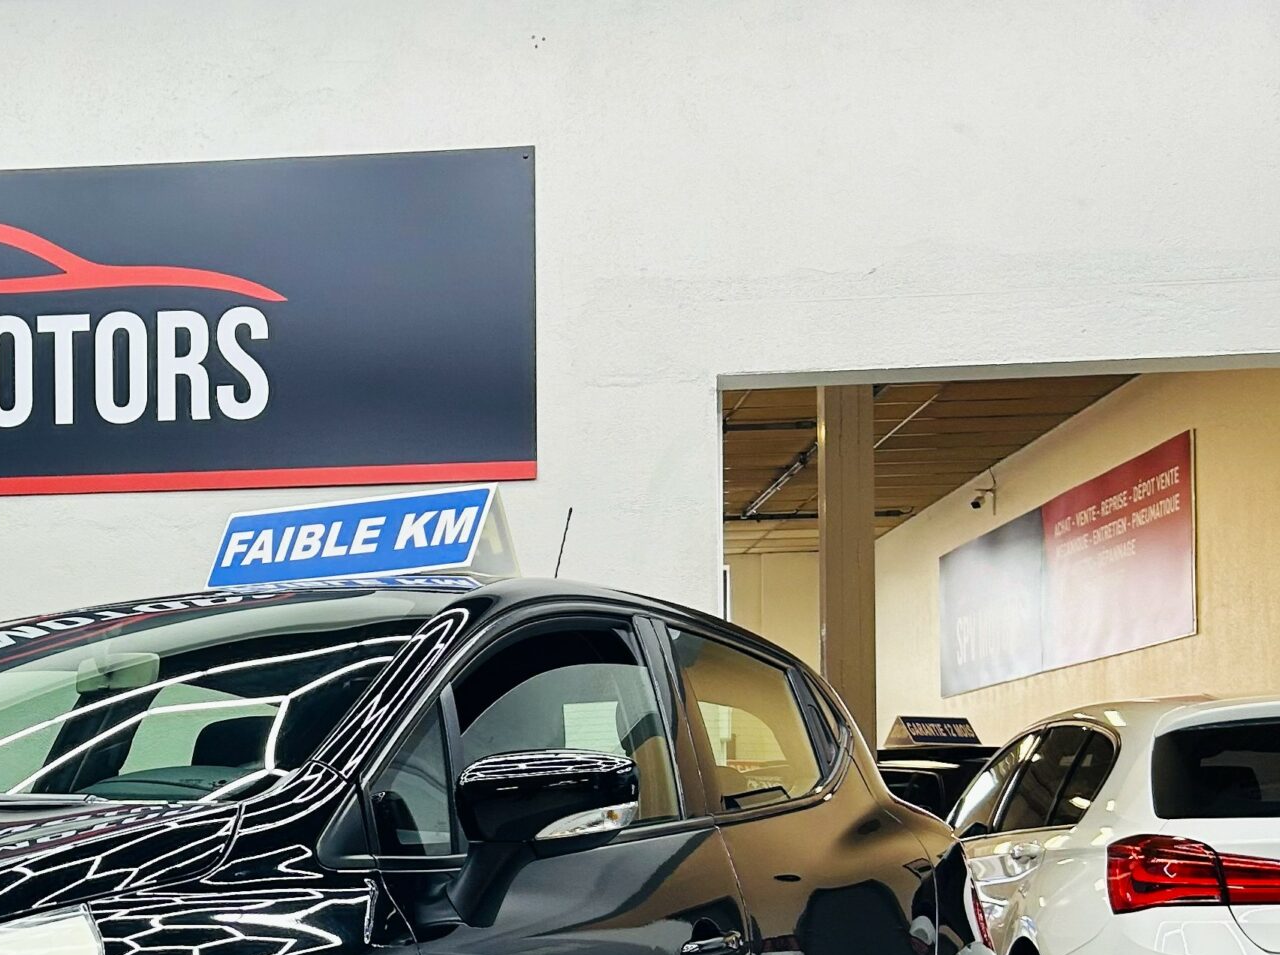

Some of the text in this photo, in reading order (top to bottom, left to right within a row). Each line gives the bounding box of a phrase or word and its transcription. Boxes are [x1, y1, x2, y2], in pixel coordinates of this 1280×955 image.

[1054, 516, 1072, 537] ACHAT
[1076, 505, 1097, 528] VENTE
[1101, 490, 1129, 517] REPRISE
[1155, 466, 1180, 492] VENTE
[1092, 516, 1127, 545] ENTRETIEN
[1131, 493, 1181, 529] PNEUMATIQUE
[221, 507, 479, 567] FAIBLE KM
[906, 722, 947, 737] GARANTIE
[952, 723, 975, 738] MOIS
